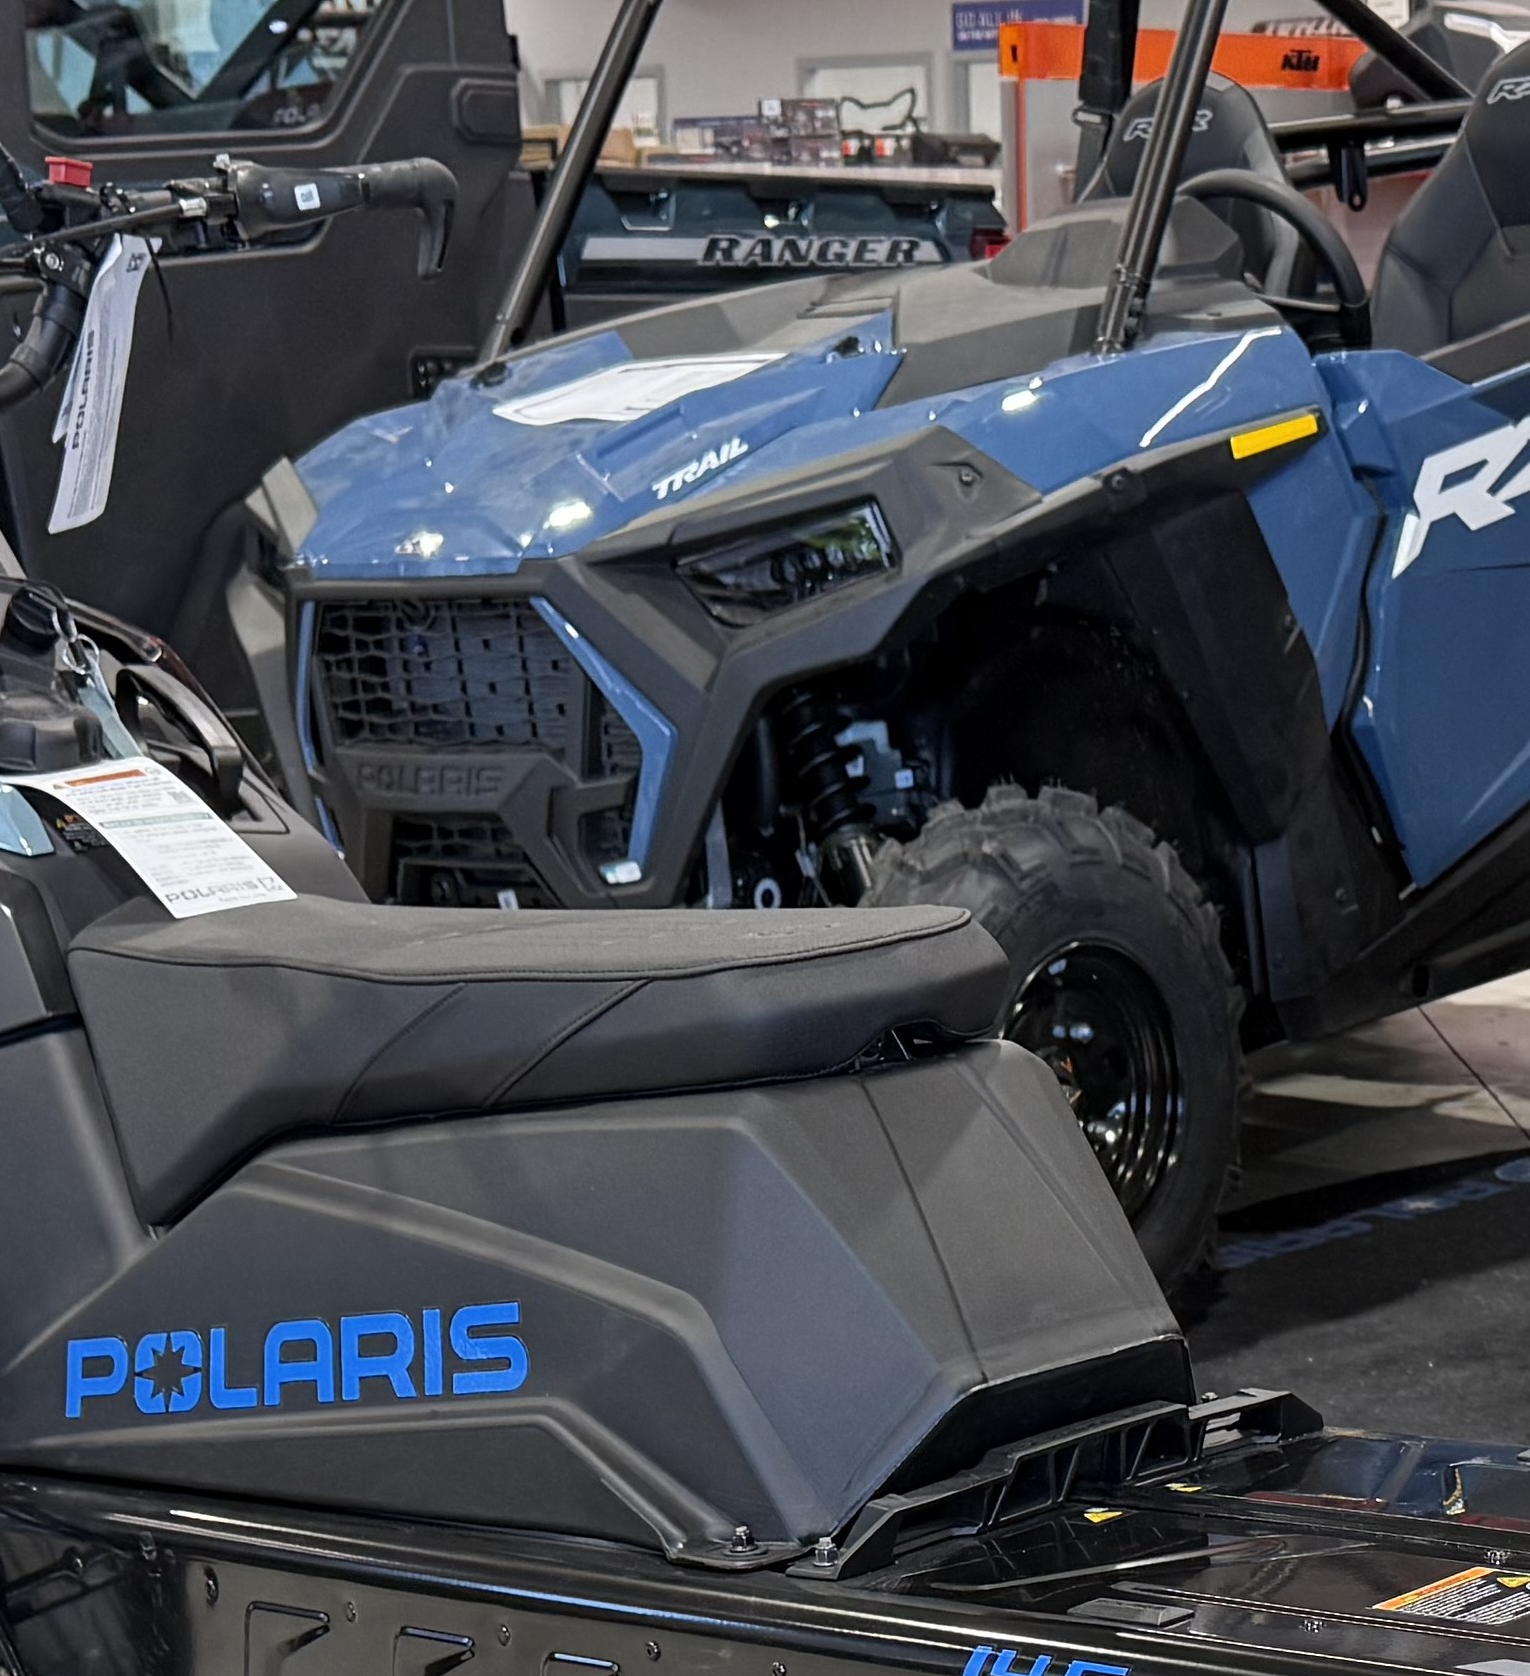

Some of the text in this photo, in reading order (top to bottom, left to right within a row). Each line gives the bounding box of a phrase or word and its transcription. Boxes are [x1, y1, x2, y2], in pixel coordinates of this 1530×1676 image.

[1281, 49, 1320, 71] KTM
[1123, 109, 1213, 142] RR
[698, 234, 920, 266] RANGER
[72, 330, 95, 450] POLARIS
[652, 437, 749, 500] TRAIL
[357, 764, 503, 795] POLARIS
[165, 879, 259, 903] POLARIS
[65, 1300, 529, 1418] POLARIS
